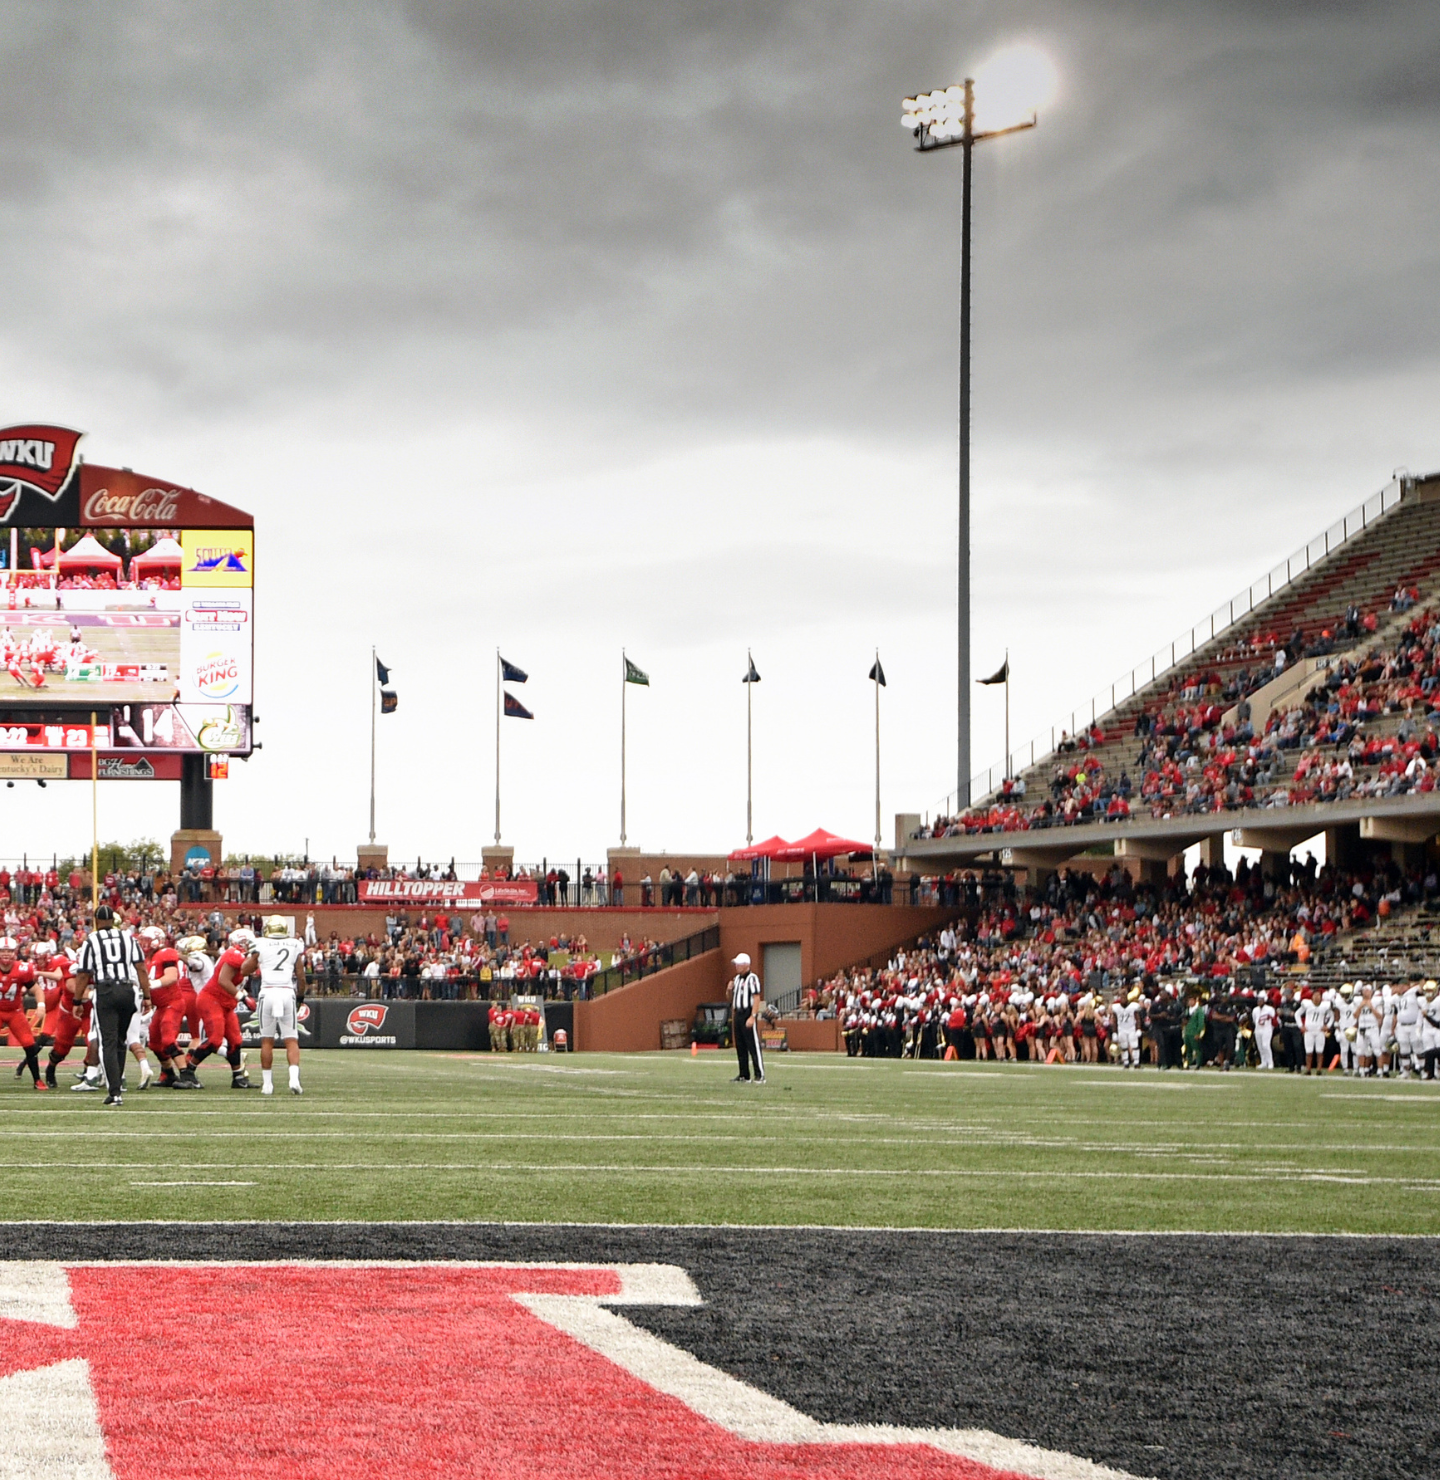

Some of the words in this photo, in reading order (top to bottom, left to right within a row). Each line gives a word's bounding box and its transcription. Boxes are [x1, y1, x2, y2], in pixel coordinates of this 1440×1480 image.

[85, 489, 182, 520] Coca-Cola
[198, 666, 238, 688] KING
[143, 709, 174, 742] 14
[10, 756, 26, 764] We
[29, 756, 44, 764] Are
[40, 764, 64, 776] Dairy
[98, 768, 153, 776] FURNISHINGS
[366, 881, 465, 896] HILLTOPPER
[102, 938, 122, 962] U
[273, 948, 290, 971] 2
[359, 1009, 378, 1020] WKU
[340, 1035, 396, 1045] @WKUSPORTS
